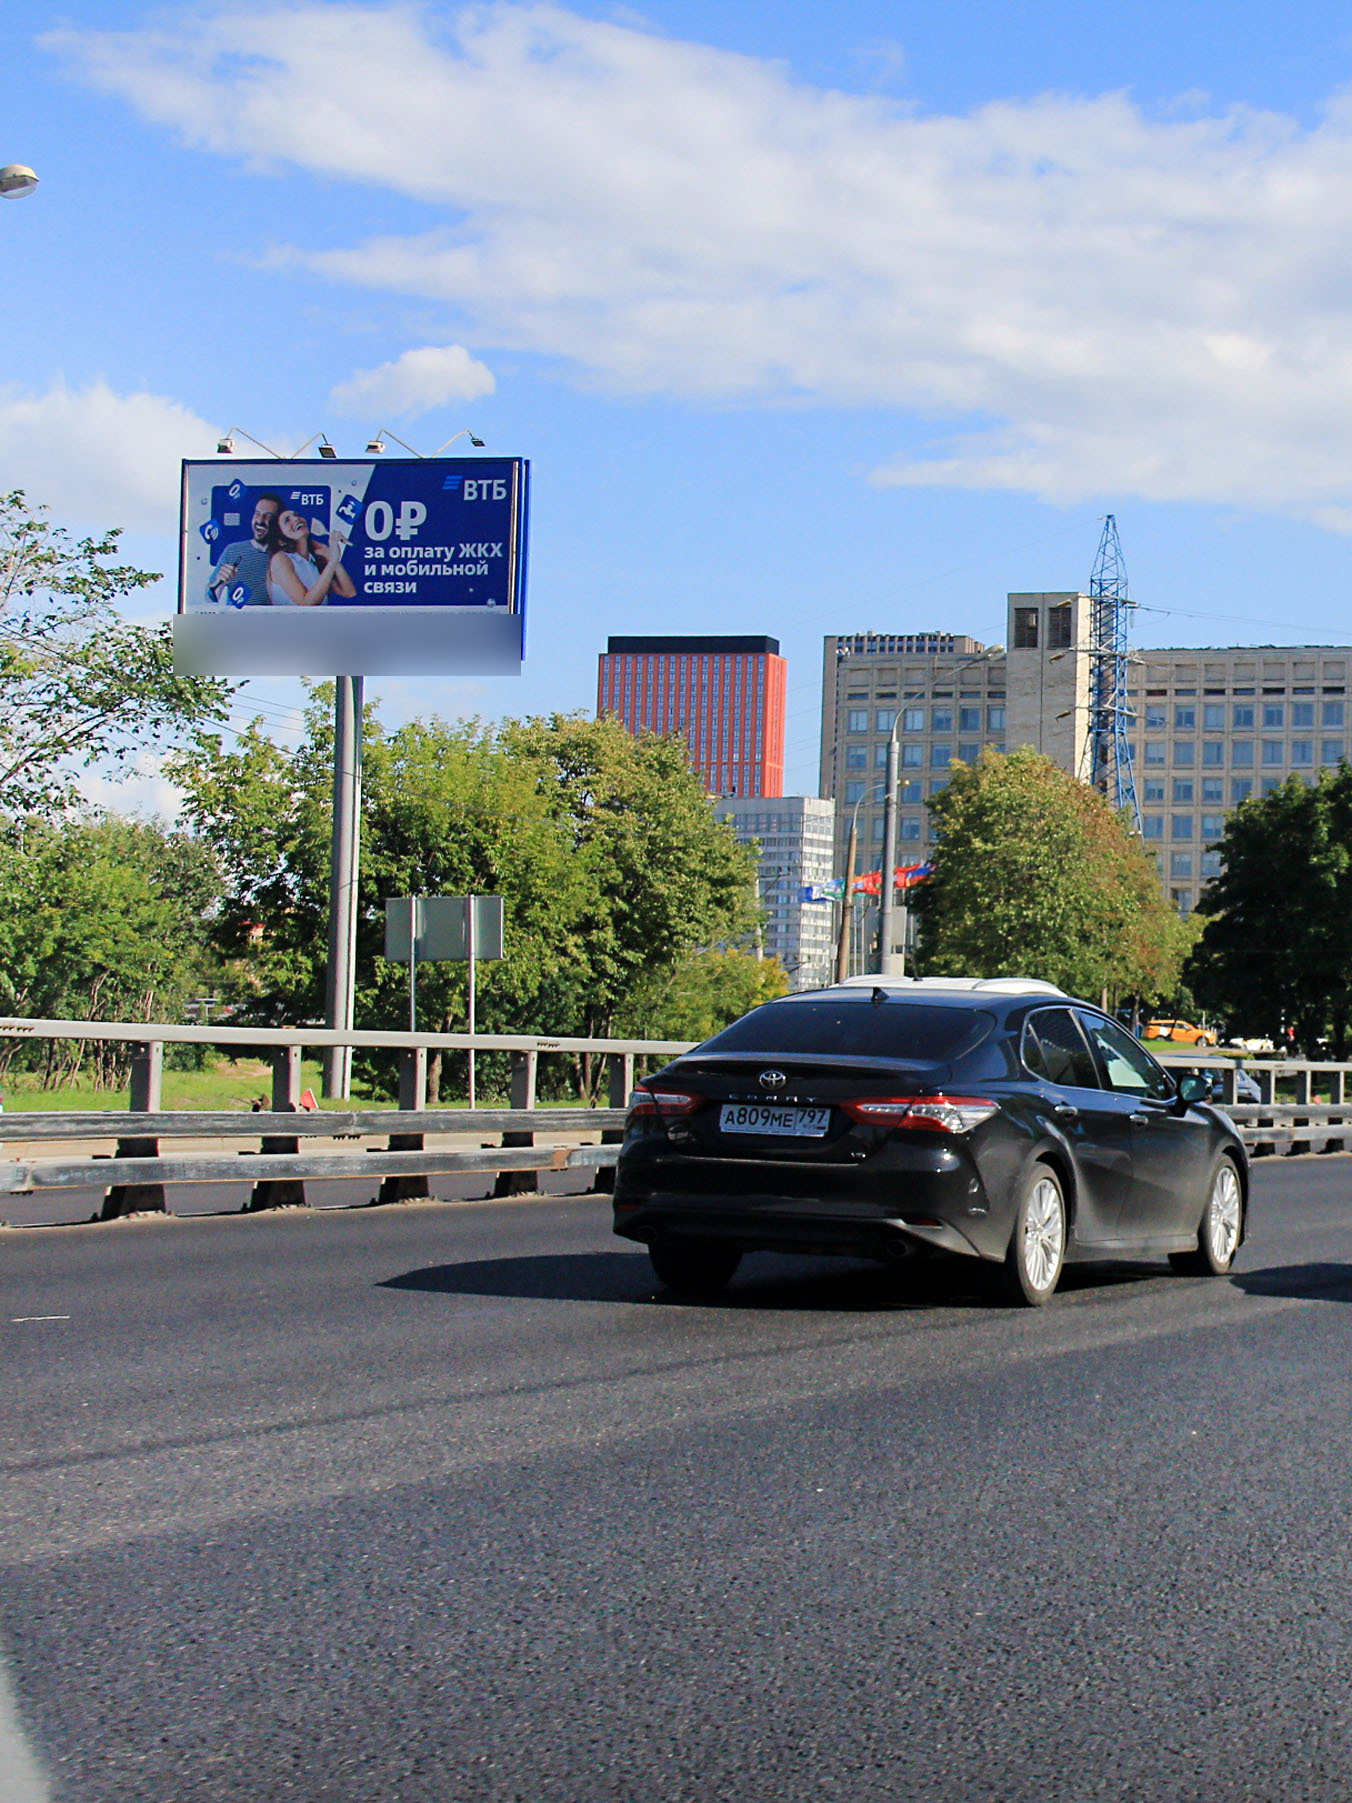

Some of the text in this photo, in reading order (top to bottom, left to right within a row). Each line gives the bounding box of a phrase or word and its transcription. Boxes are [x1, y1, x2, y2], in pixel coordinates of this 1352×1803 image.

[464, 479, 507, 501] ВТБ
[301, 494, 324, 505] ВТБ
[364, 542, 503, 562] за оплату ЖКХ
[364, 560, 489, 576] и мобильной
[364, 581, 417, 594] связи
[800, 1109, 826, 1125] 797
